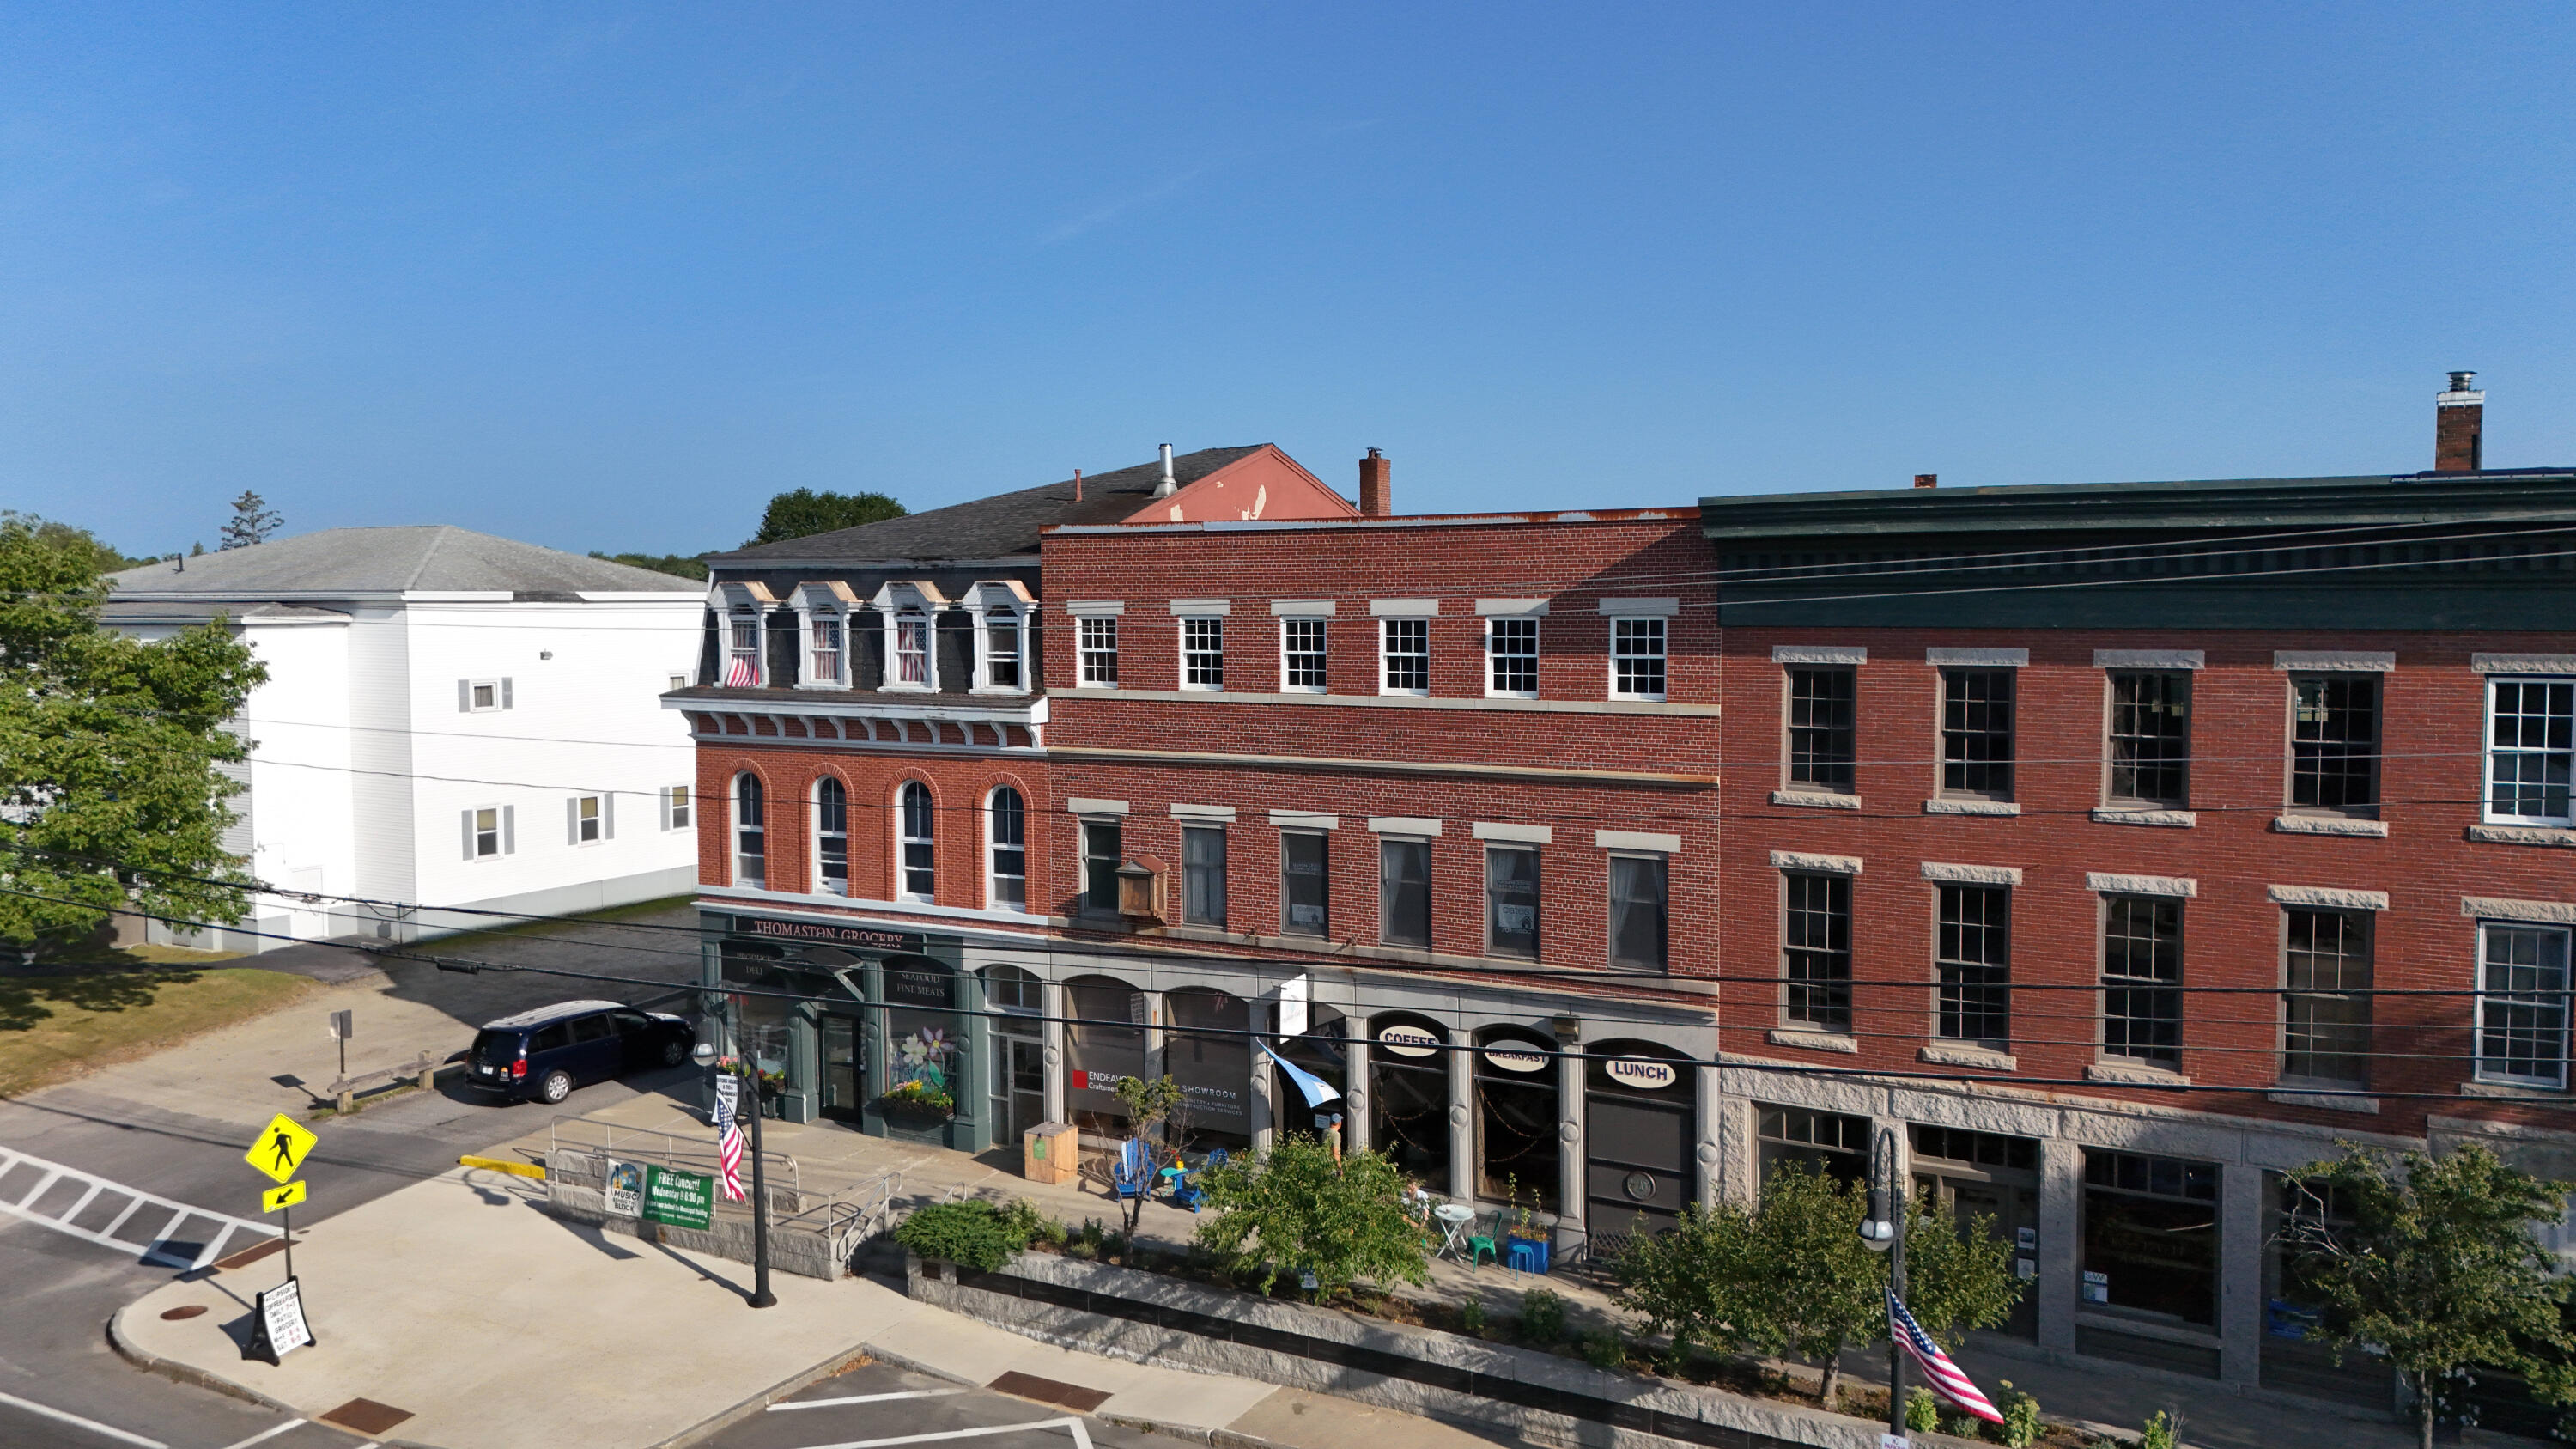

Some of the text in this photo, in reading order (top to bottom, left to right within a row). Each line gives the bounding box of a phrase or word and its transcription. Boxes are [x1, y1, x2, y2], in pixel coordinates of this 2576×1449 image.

[754, 921, 903, 948] THOMASTON GROCERY
[745, 965, 763, 976] DELI
[901, 972, 940, 983] SEAFOOD
[896, 983, 945, 997] FINE MEATS
[1384, 1032, 1436, 1045] COFFEE
[1614, 1062, 1668, 1080] LUNCH
[1088, 1081, 1119, 1093] Craftsmen
[1182, 1085, 1236, 1099] SHOWROOM
[1211, 1101, 1241, 1111] FURNITURE
[659, 1172, 701, 1191] FREE Concert!
[614, 1190, 637, 1201] MUSIC
[652, 1185, 680, 1202] Wednesday
[696, 1196, 705, 1206] pm
[614, 1202, 635, 1212] BLOCK
